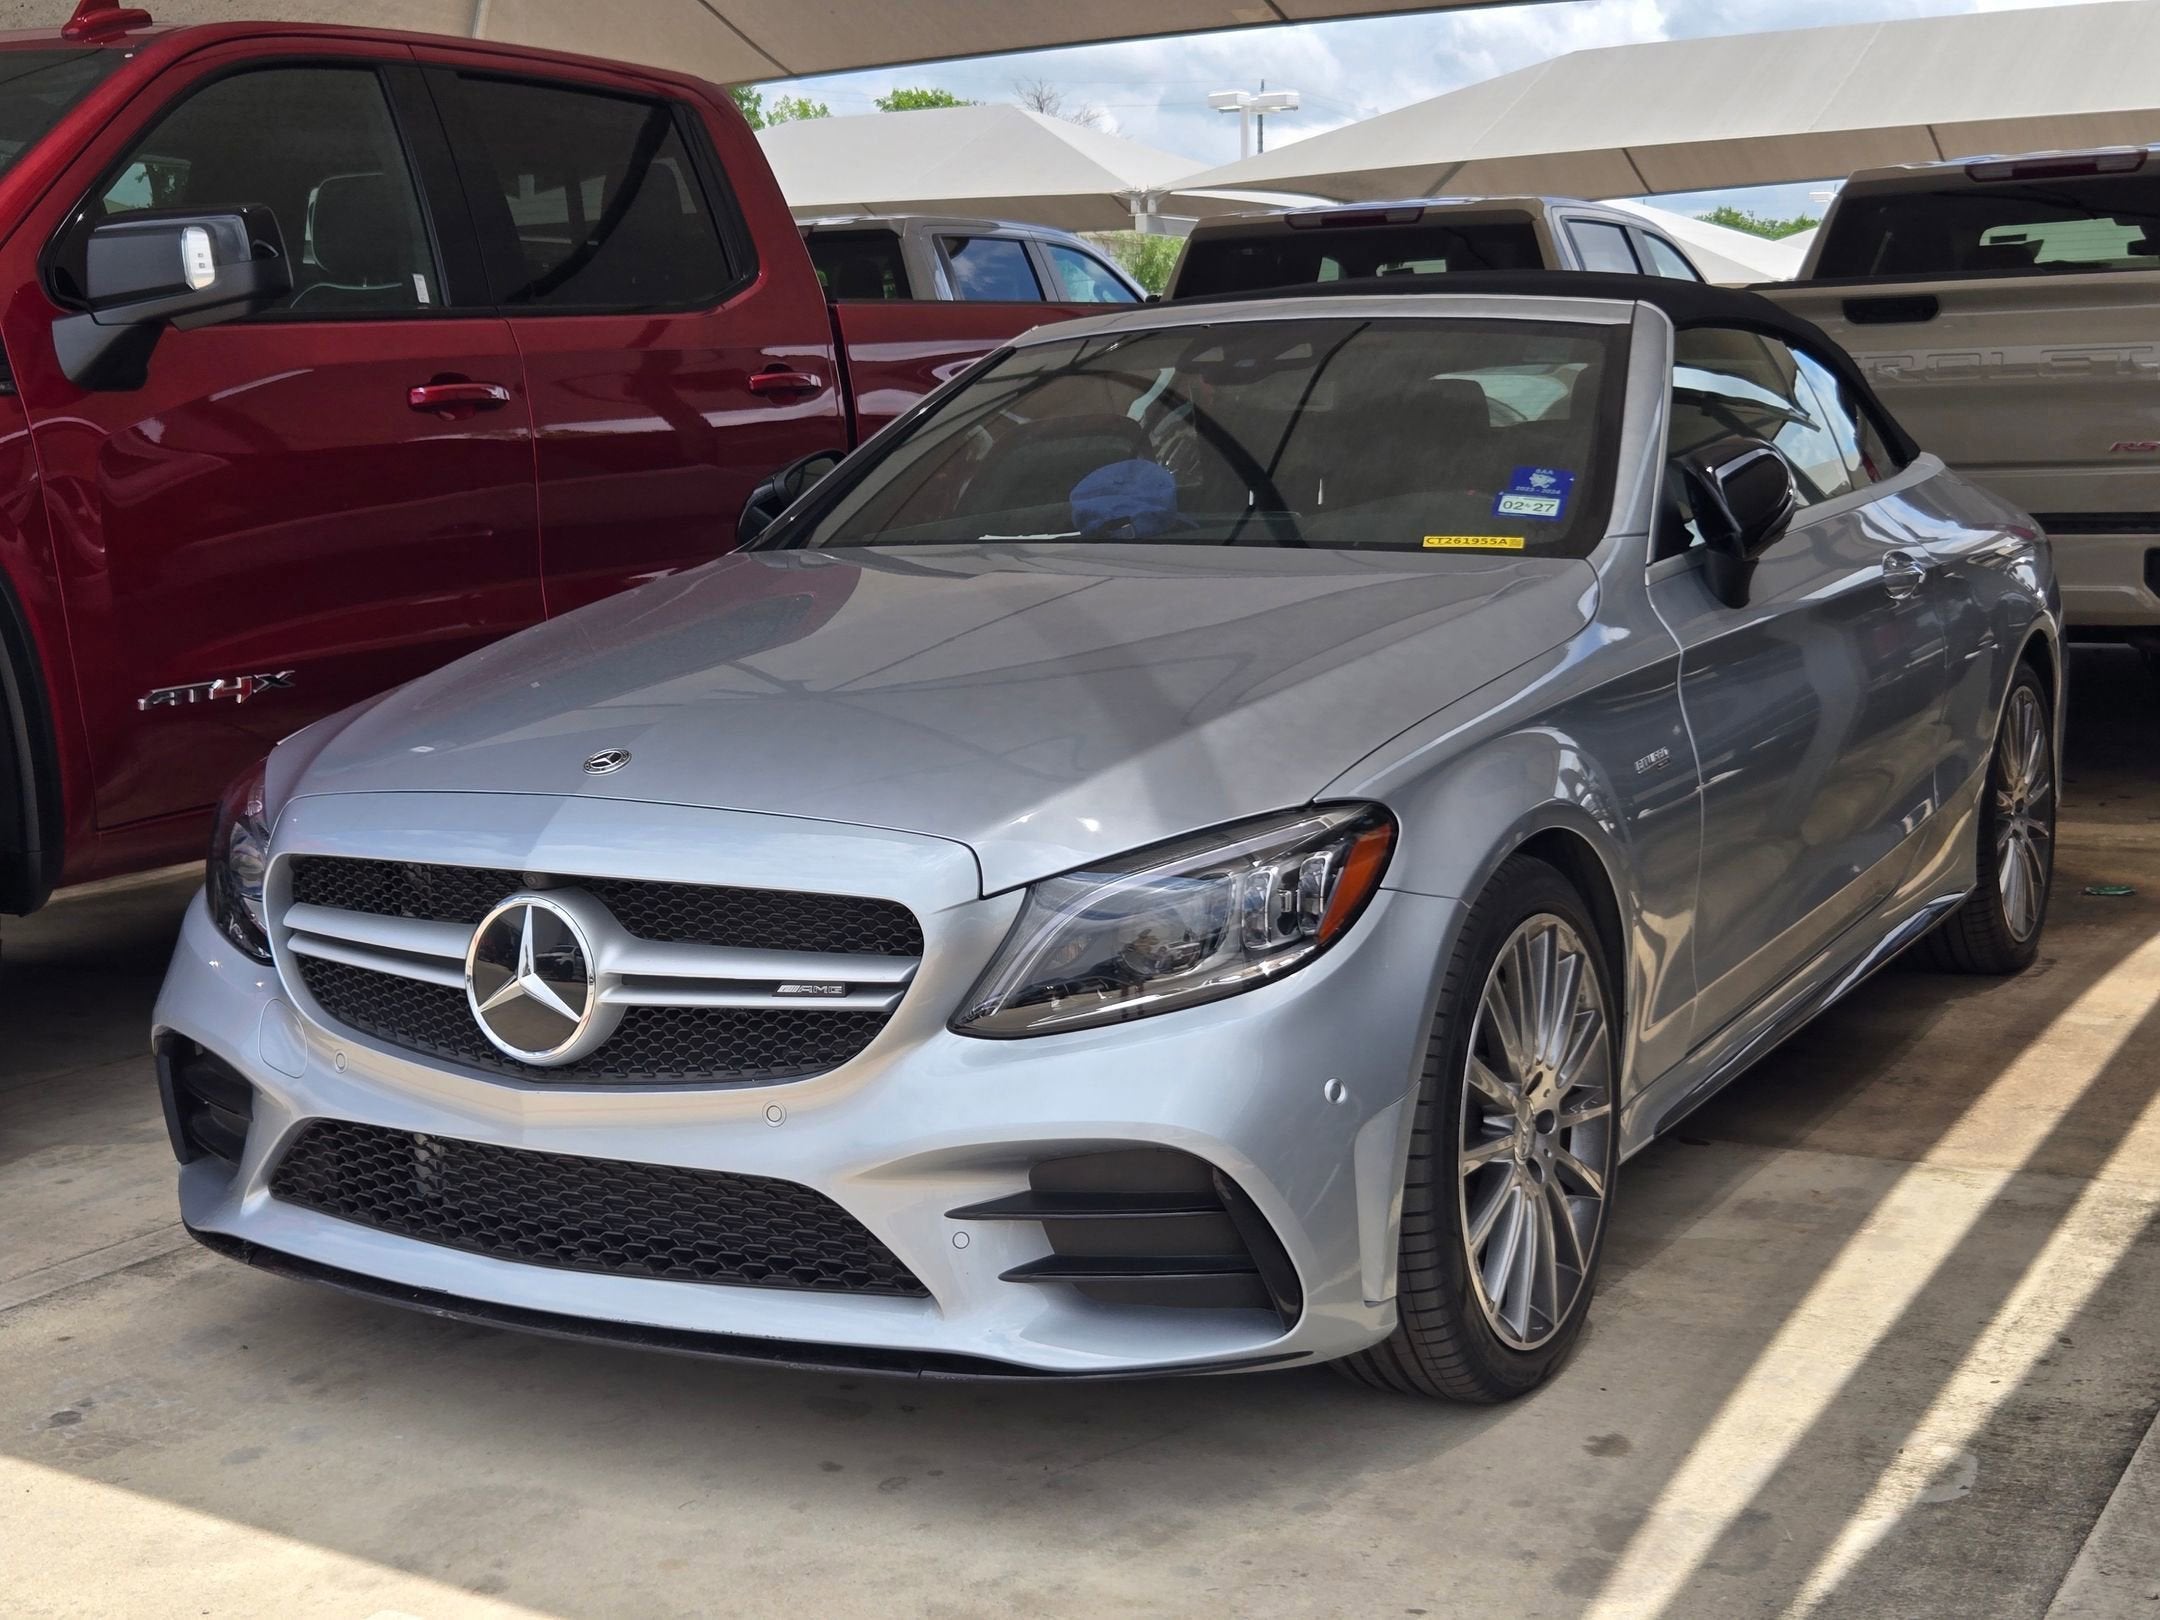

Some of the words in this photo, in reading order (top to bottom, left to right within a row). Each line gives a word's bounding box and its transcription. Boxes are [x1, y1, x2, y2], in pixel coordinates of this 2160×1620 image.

[2108, 440, 2160, 452] RS
[138, 670, 296, 711] AT4X
[799, 985, 842, 994] AMG
